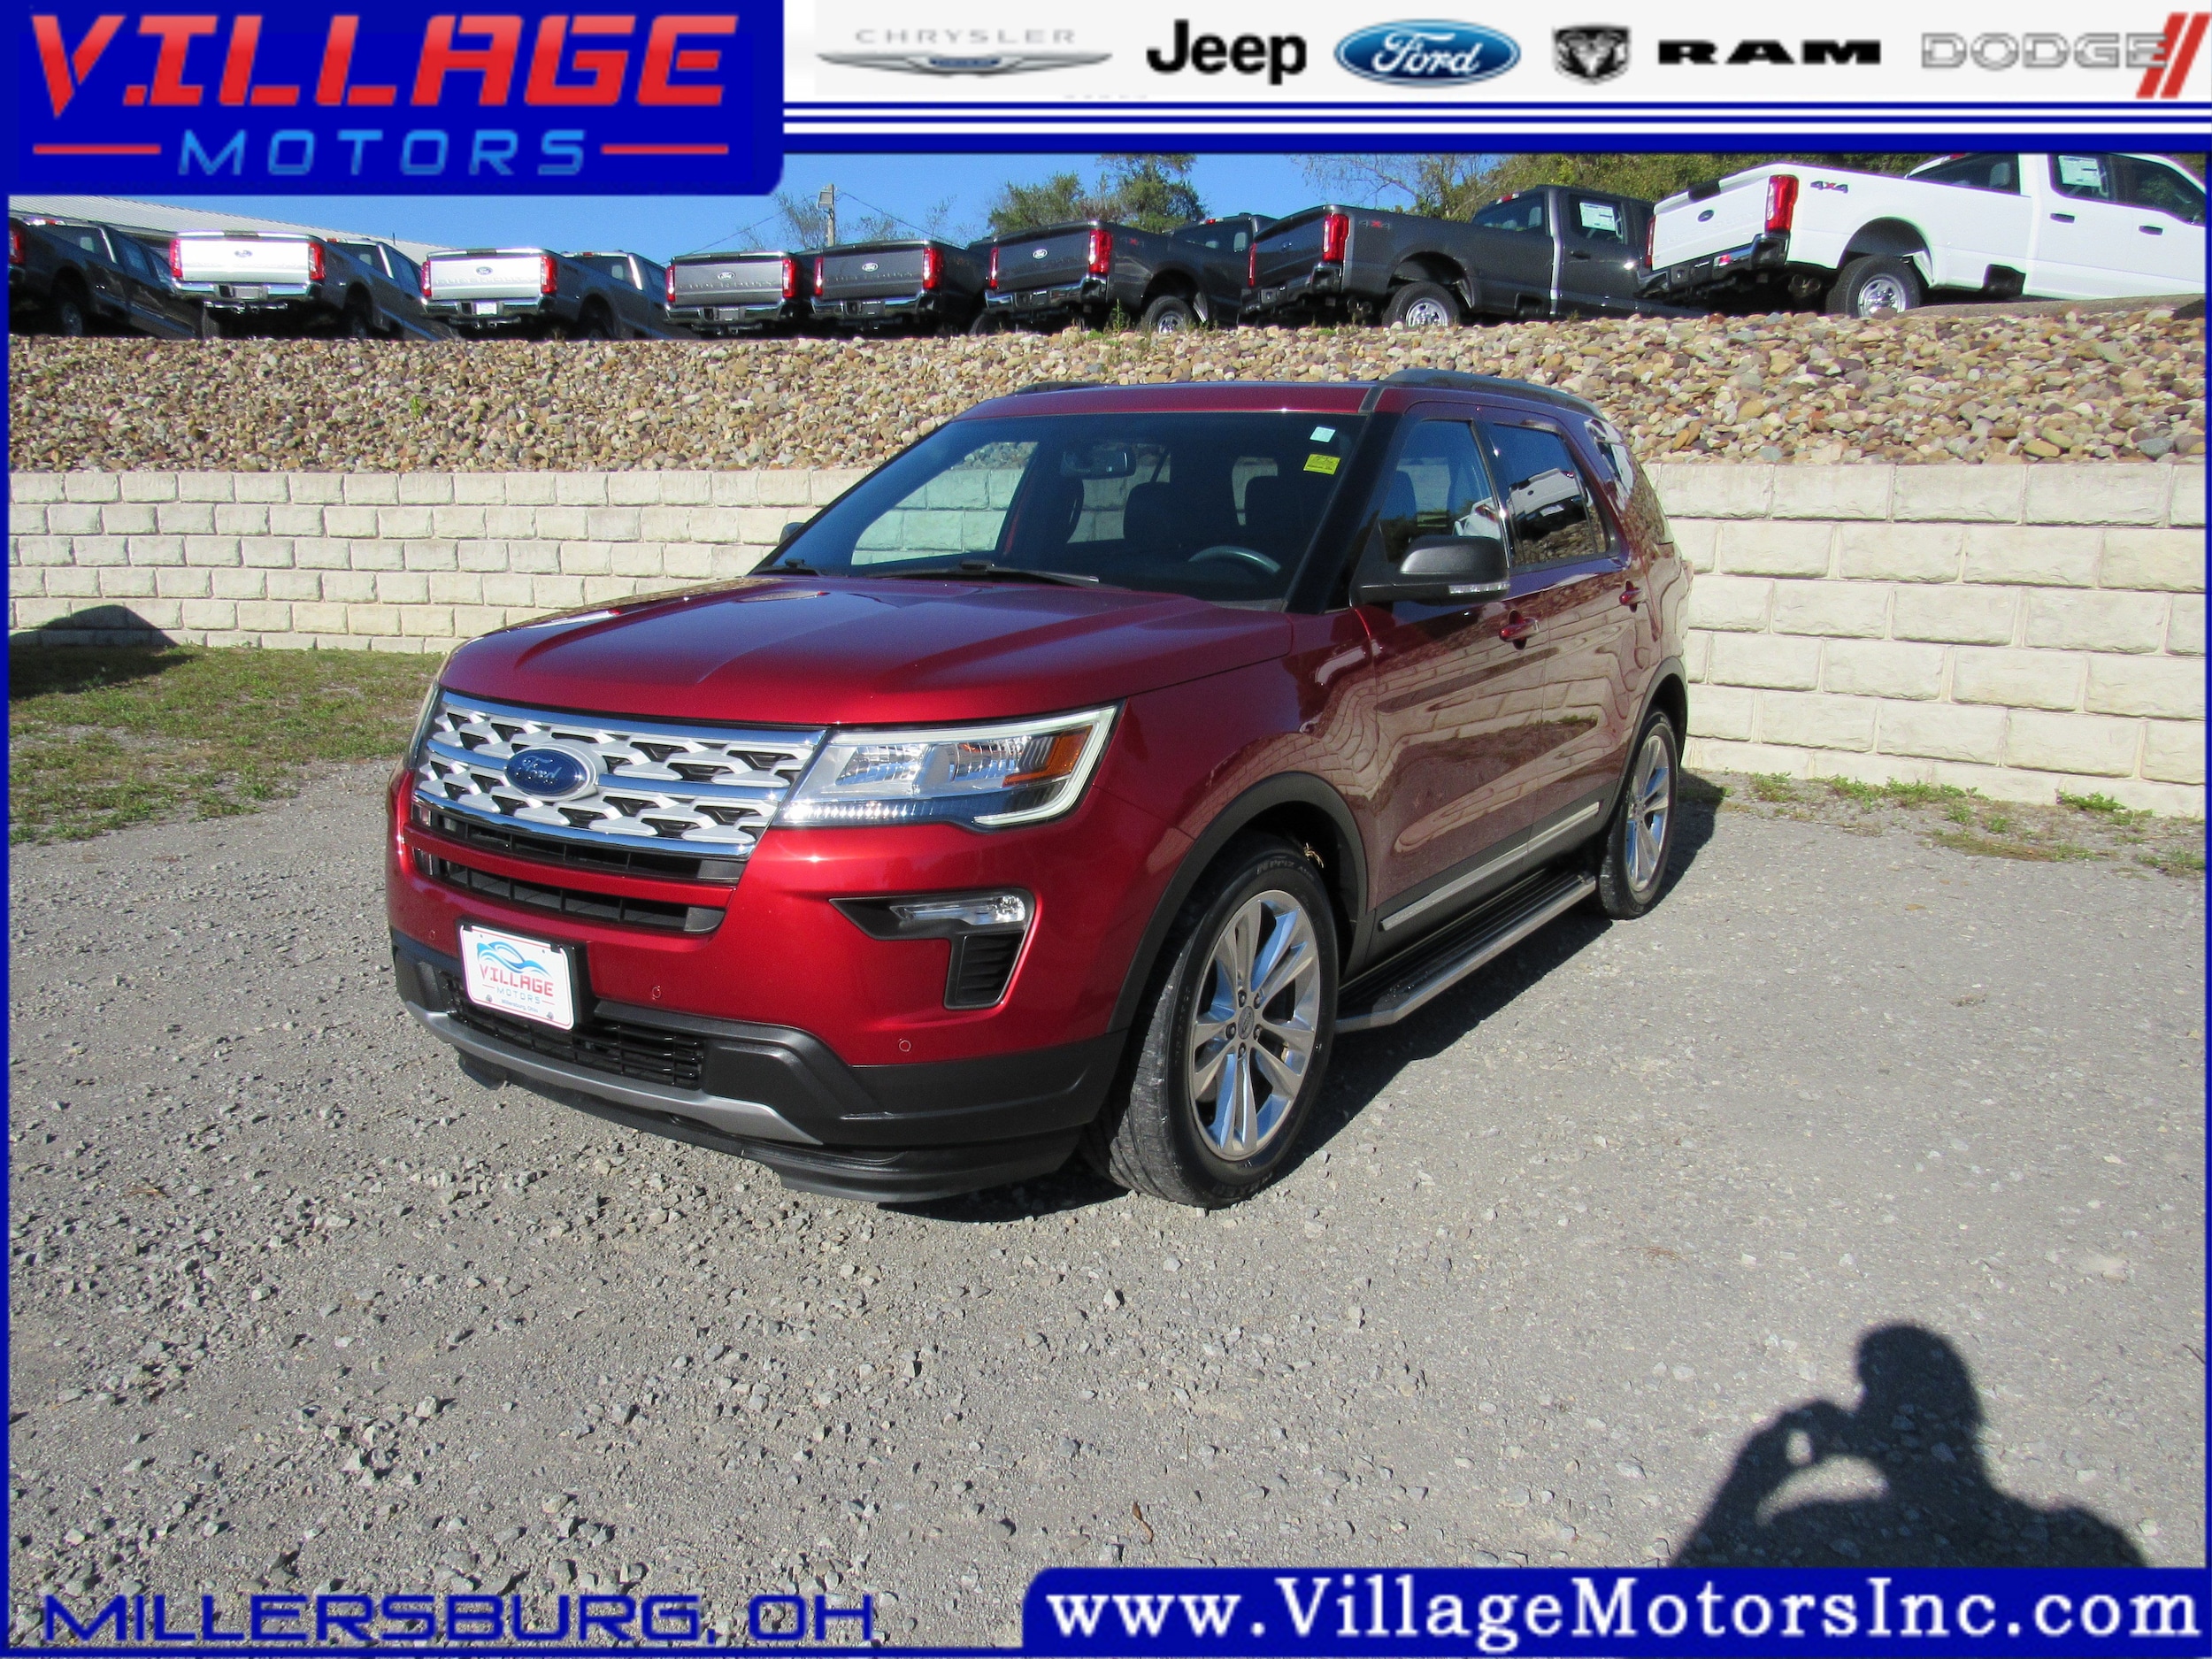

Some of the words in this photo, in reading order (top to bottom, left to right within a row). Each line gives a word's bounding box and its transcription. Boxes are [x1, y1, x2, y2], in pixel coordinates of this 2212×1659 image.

[521, 754, 563, 780] Ford
[479, 964, 554, 997] VILLAGE
[496, 987, 541, 1004] MOTORS
